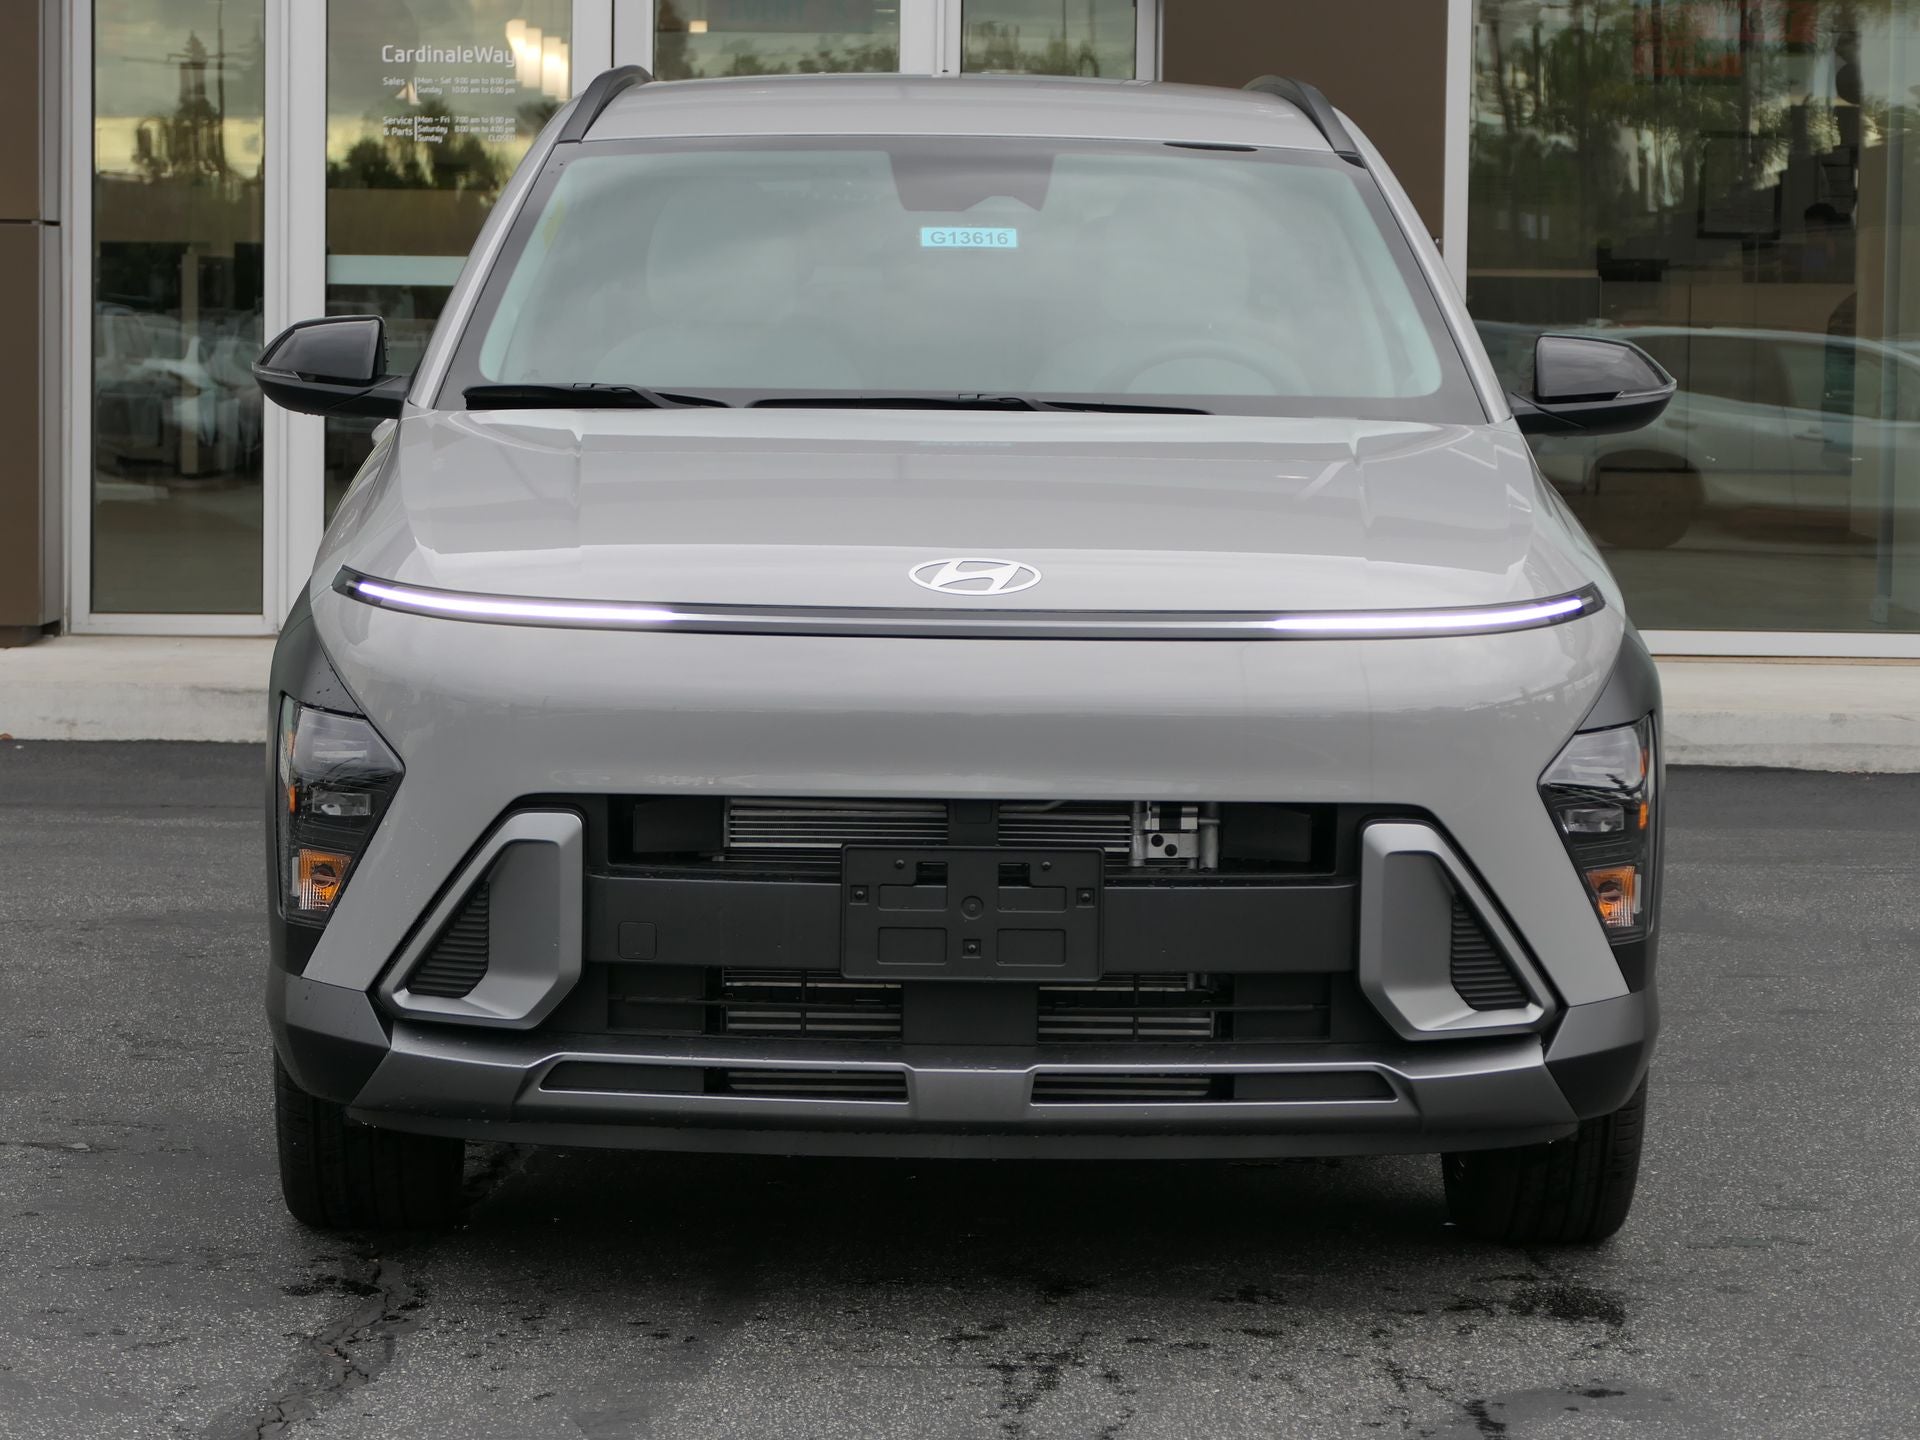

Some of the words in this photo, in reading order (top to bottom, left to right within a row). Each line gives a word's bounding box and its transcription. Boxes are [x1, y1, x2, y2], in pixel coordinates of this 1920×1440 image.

[381, 44, 516, 68] CardinaleWay
[382, 77, 406, 86] Sales
[417, 86, 443, 95] Sunday
[383, 116, 414, 125] Service
[391, 128, 414, 136] Parts
[417, 125, 449, 135] Saturday
[417, 134, 443, 144] Sunday
[930, 231, 1009, 245] G13616
